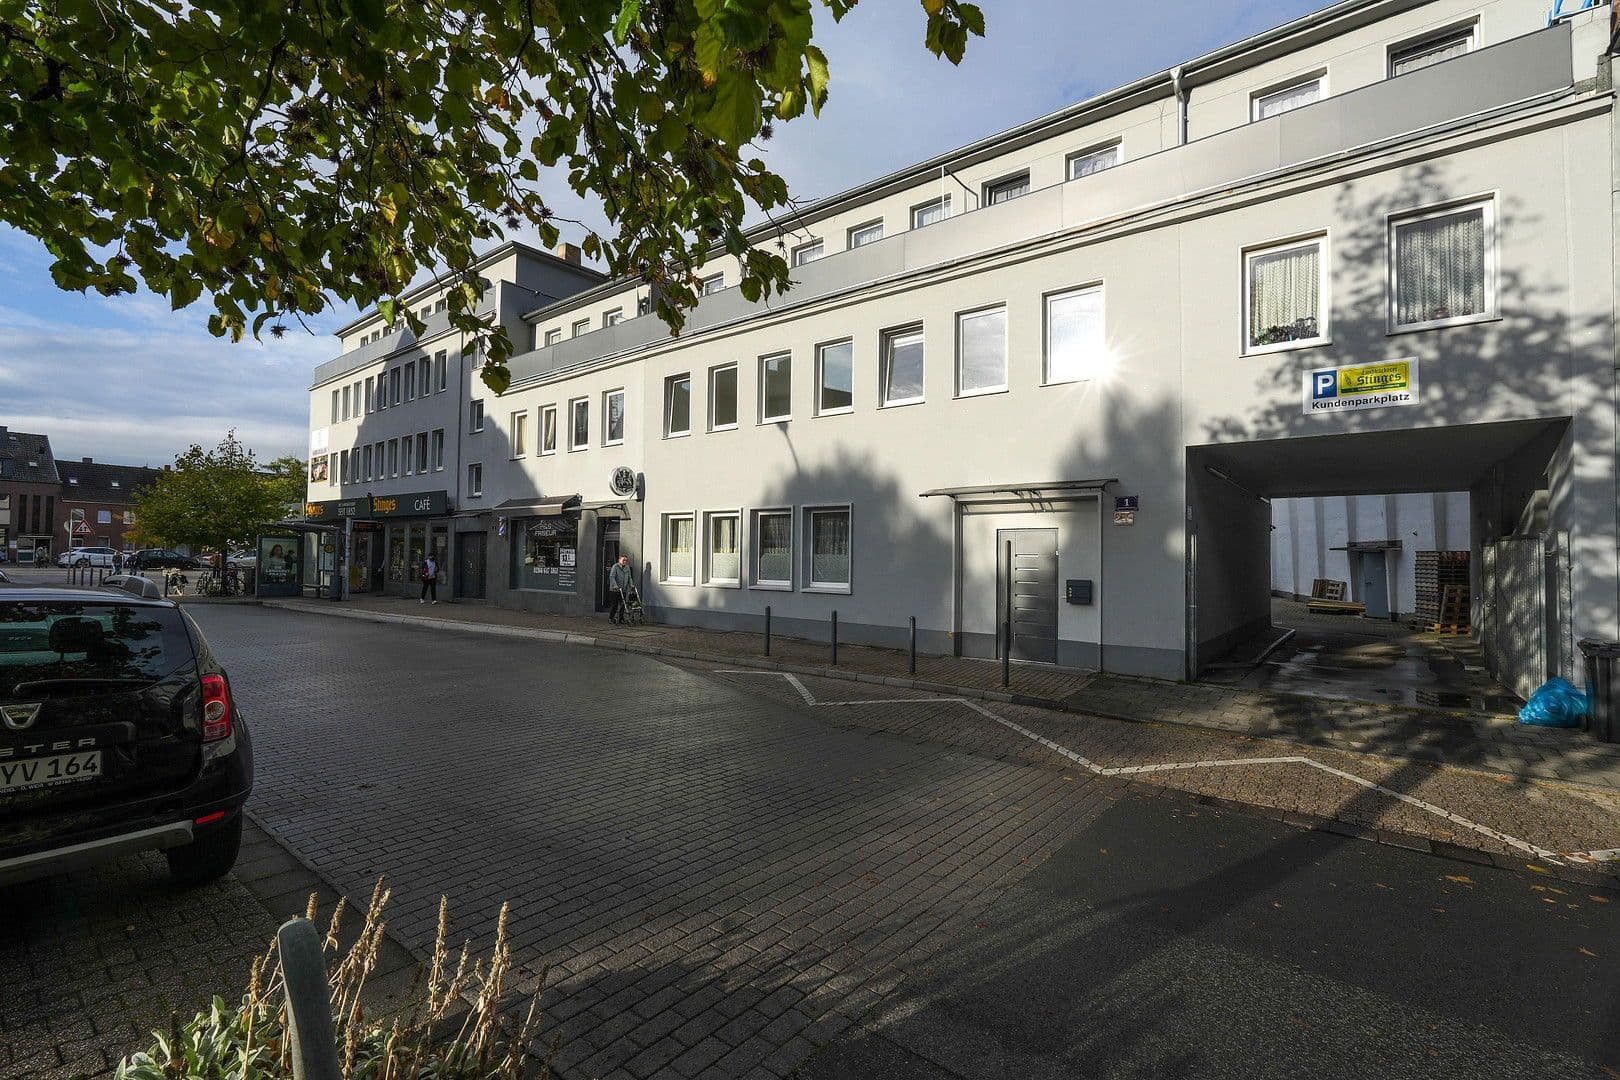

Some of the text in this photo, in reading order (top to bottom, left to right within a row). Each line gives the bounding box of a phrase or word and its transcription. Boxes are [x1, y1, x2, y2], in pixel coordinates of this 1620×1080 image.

[1357, 373, 1402, 385] Stinges
[1312, 393, 1410, 410] Kundenparkplatz
[373, 496, 397, 513] Stinges
[414, 496, 431, 511] CAFÉ
[46, 754, 98, 779] 164
